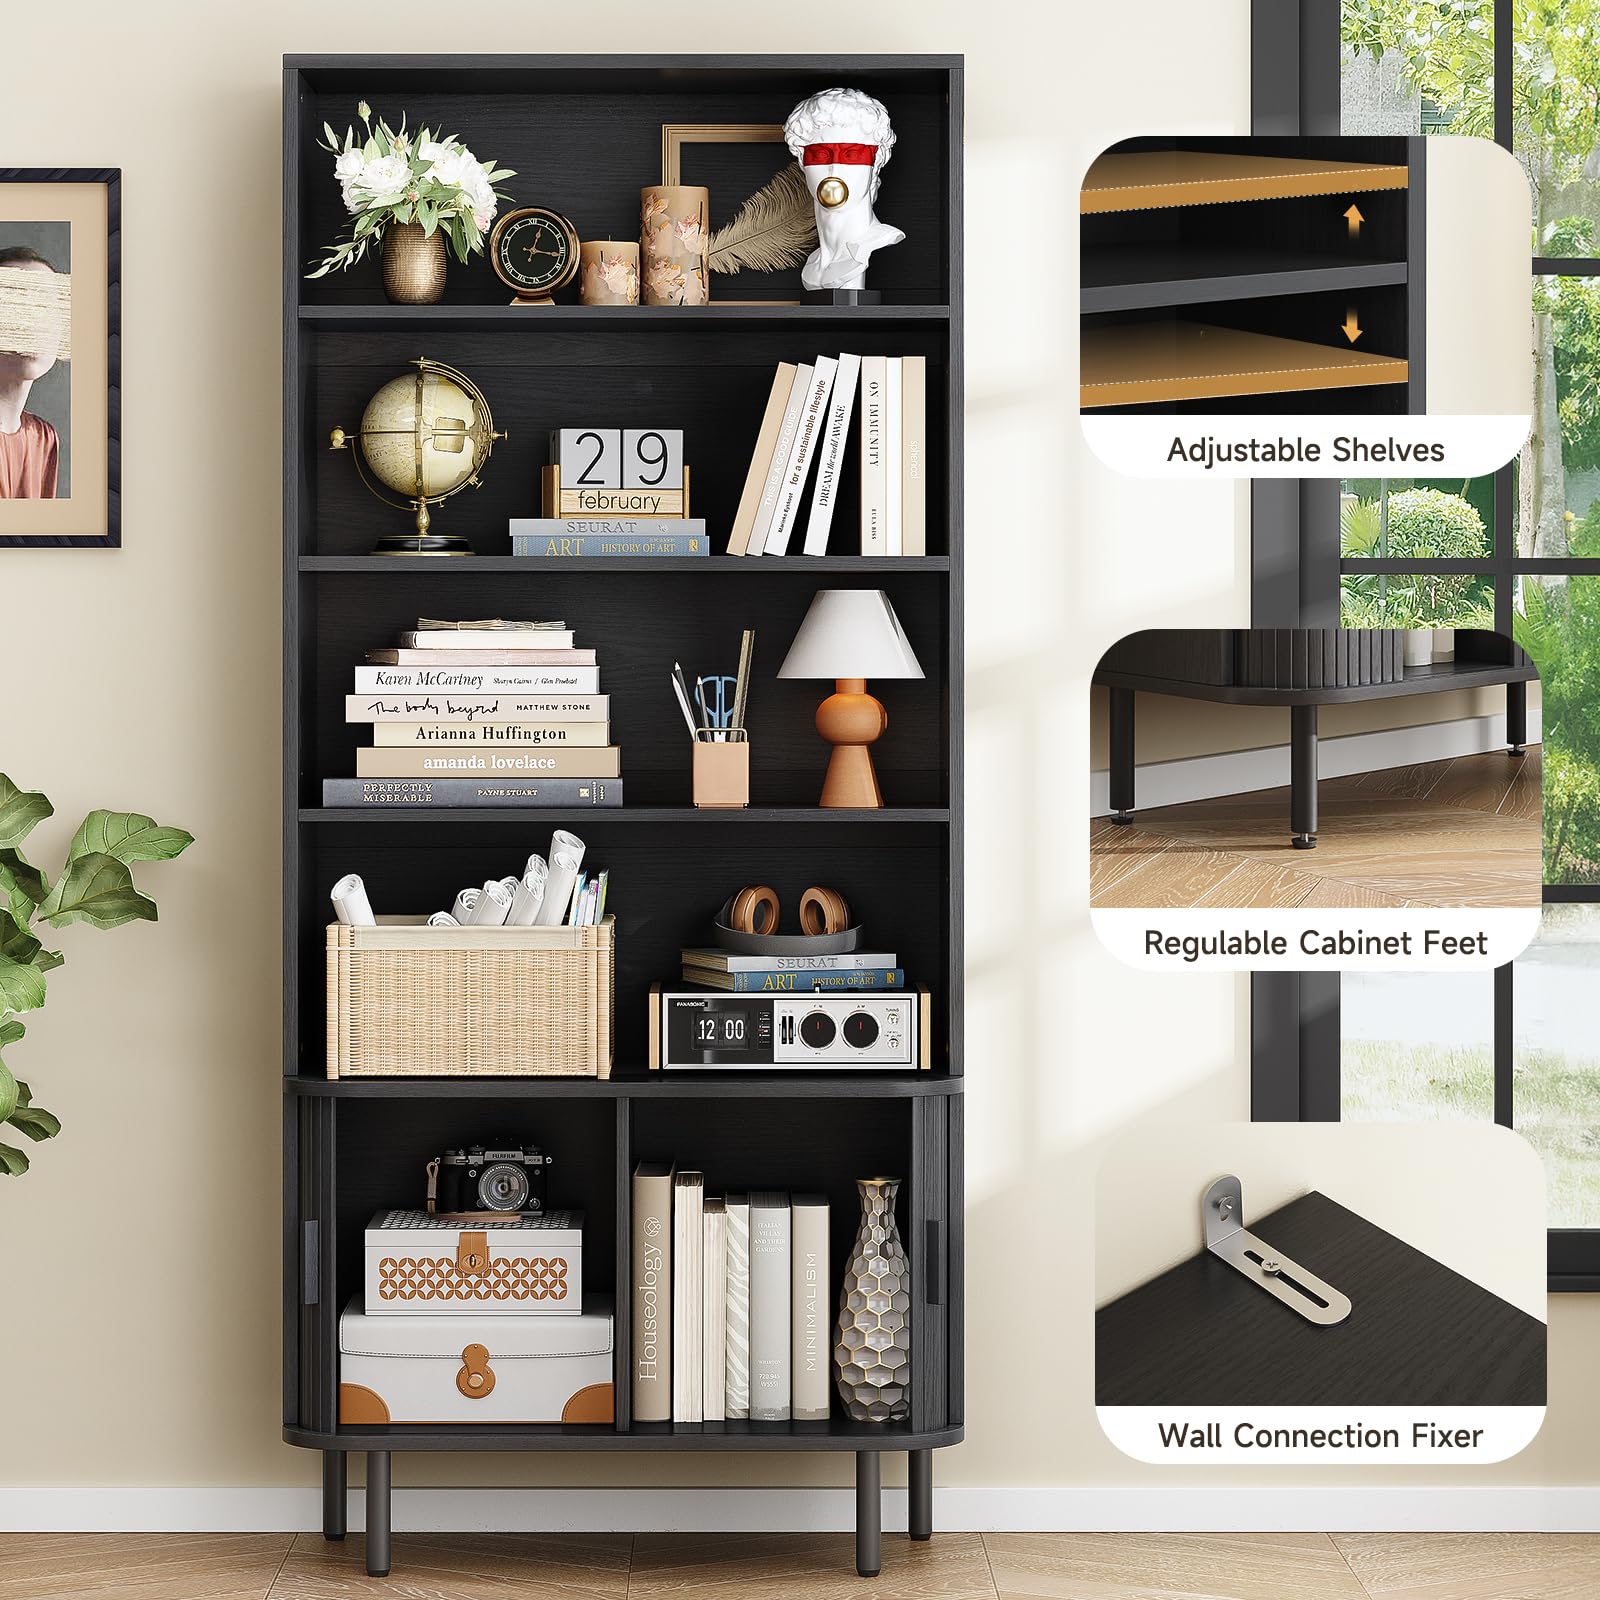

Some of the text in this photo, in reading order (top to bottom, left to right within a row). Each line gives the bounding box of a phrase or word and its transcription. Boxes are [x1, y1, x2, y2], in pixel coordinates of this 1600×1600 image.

[785, 407, 798, 435] GUIDE
[868, 381, 879, 466] ON IMMUNITY
[790, 473, 799, 485] for
[798, 415, 816, 464] sustainable
[810, 380, 826, 414] lifestyle
[776, 437, 789, 465] GOOD
[819, 471, 834, 507] DREAM
[832, 405, 846, 439] AWAKE
[770, 475, 779, 485] IS
[578, 490, 661, 514] february
[765, 486, 776, 506] THIS
[566, 522, 638, 534] SEURAT
[544, 538, 585, 556] ART
[601, 543, 676, 553] HISTORY OF ART
[375, 671, 484, 690] Karen McCartney
[368, 698, 499, 721] The body beyond
[416, 726, 567, 743] Arianna Huffington
[423, 755, 557, 769] amanda lovelace
[363, 783, 433, 792] PERFECTLY
[363, 794, 433, 802] MISERABLE
[777, 957, 838, 969] SEURAT
[762, 974, 798, 991] ART
[812, 978, 846, 986] HISTORY
[860, 976, 876, 984] ART
[725, 1020, 744, 1040] 00
[639, 1242, 662, 1382] Houseology
[806, 1252, 816, 1372] MINIMALISM
